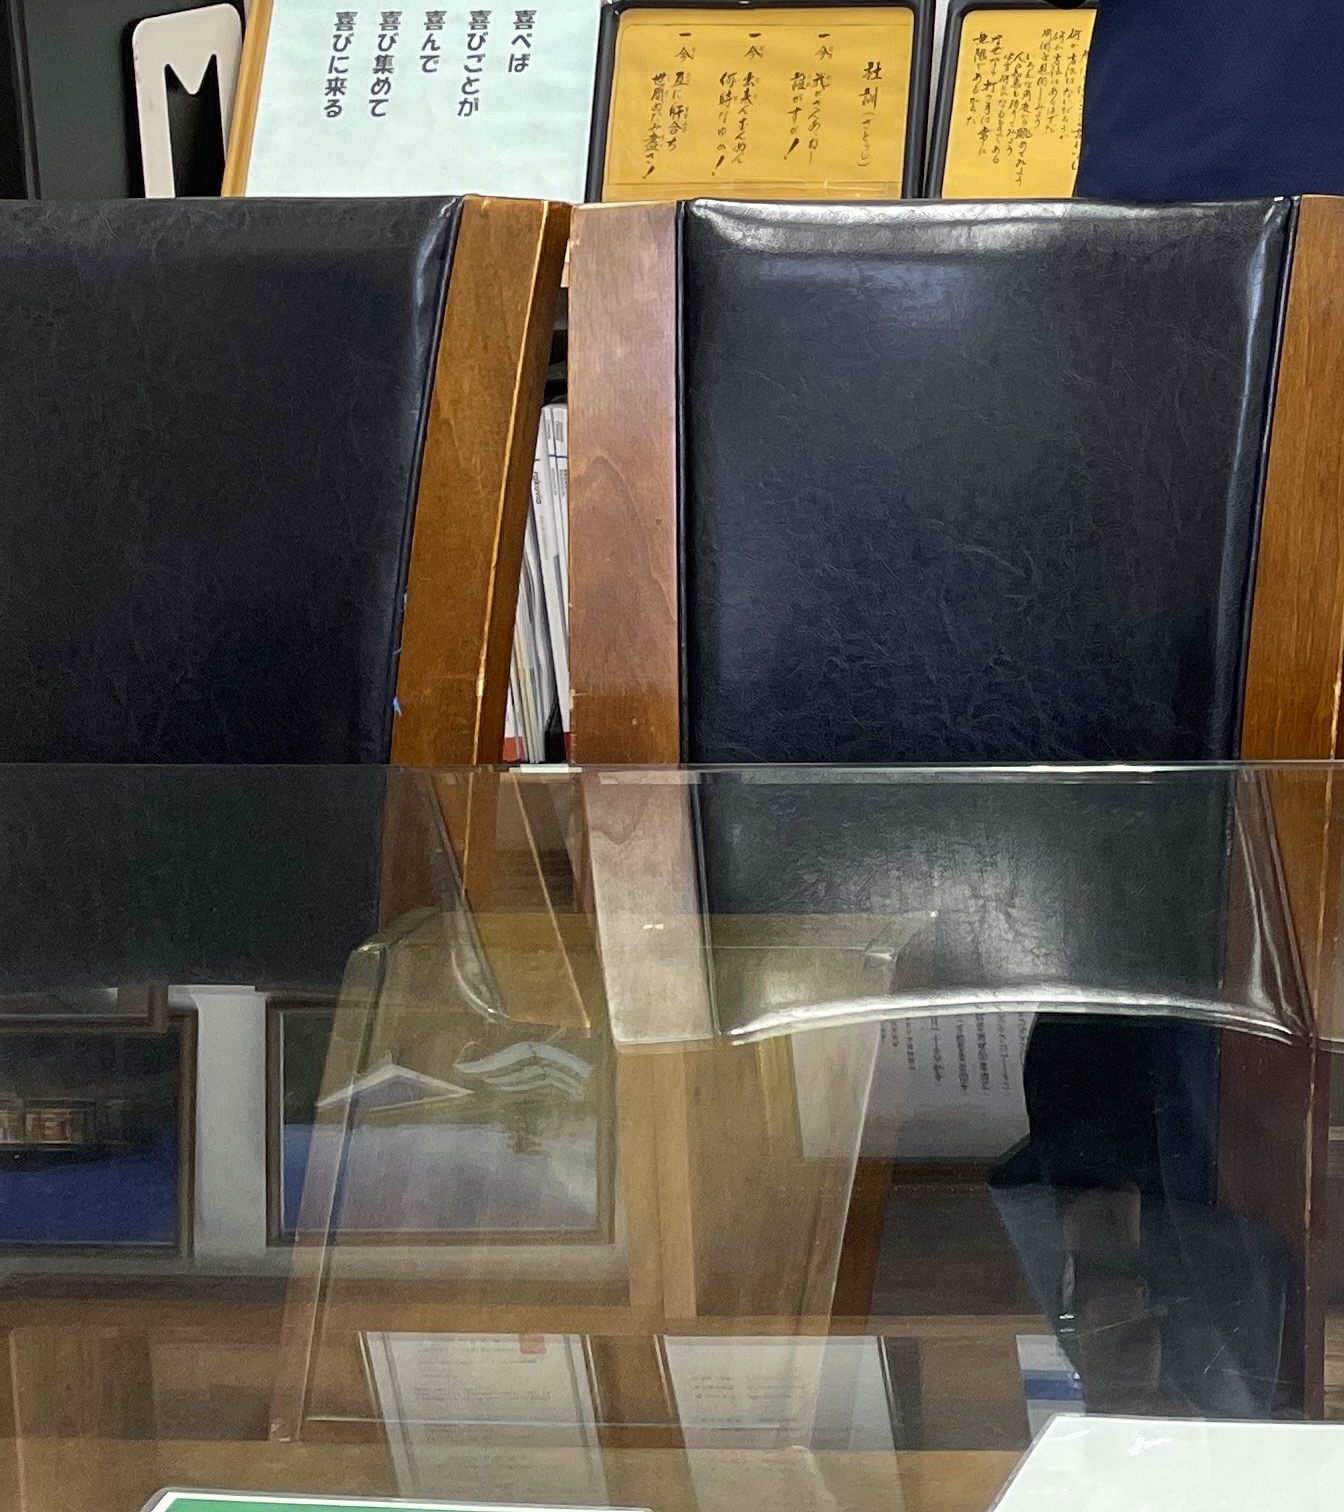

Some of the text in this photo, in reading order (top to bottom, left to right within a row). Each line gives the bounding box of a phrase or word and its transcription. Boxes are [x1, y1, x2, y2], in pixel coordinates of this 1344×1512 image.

[324, 11, 358, 118] 喜びに来る
[368, 10, 403, 117] 喜び集めて
[419, 10, 447, 73] 喜んで
[457, 10, 492, 117] 喜びごとが
[507, 10, 537, 73] 喜べば
